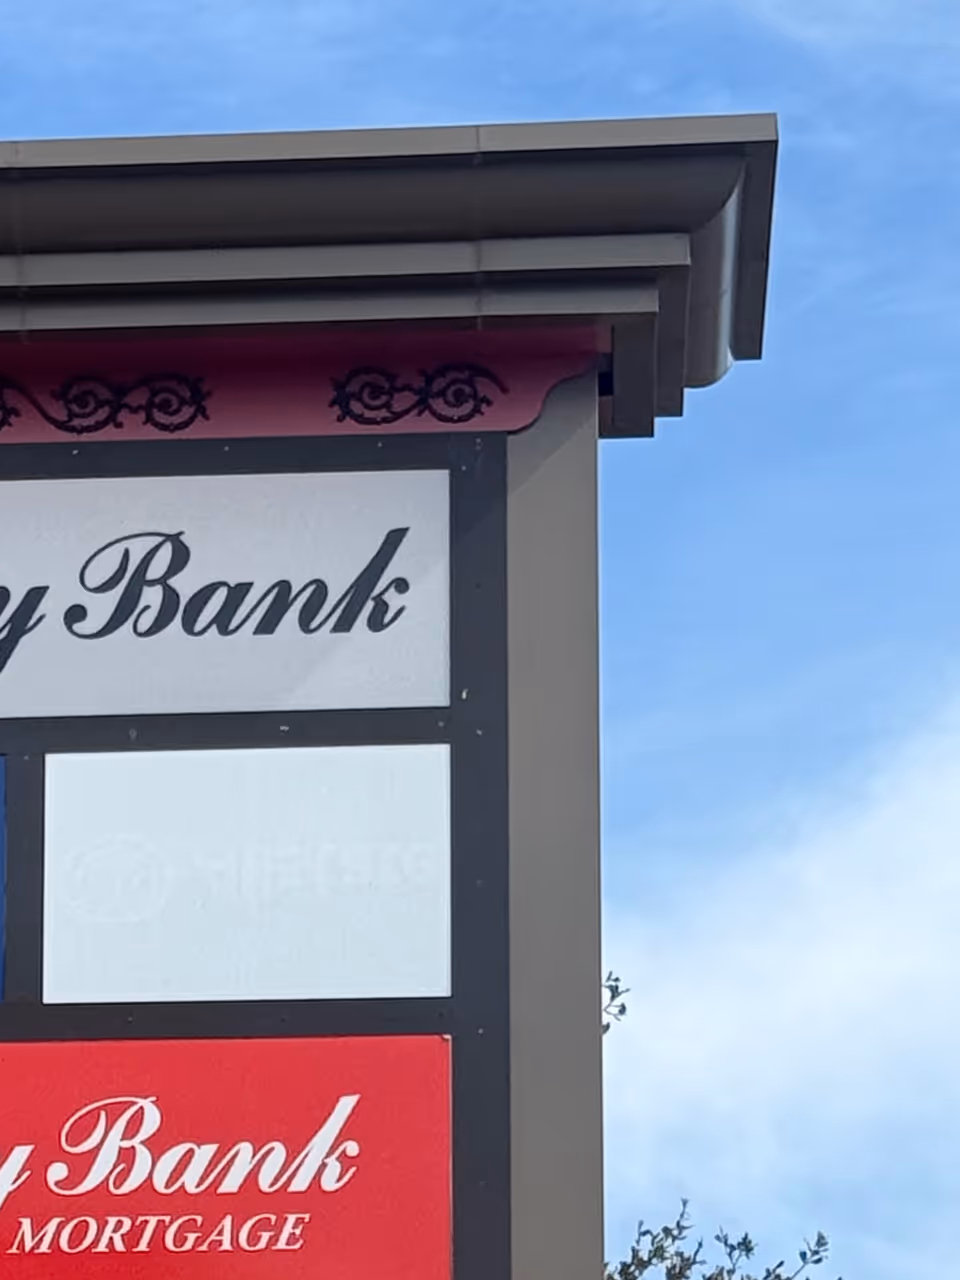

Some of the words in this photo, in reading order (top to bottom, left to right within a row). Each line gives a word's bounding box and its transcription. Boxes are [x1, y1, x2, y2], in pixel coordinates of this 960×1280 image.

[62, 526, 411, 640] Bank
[46, 1093, 362, 1196] Bank
[6, 1213, 311, 1255] MORTGAGE
